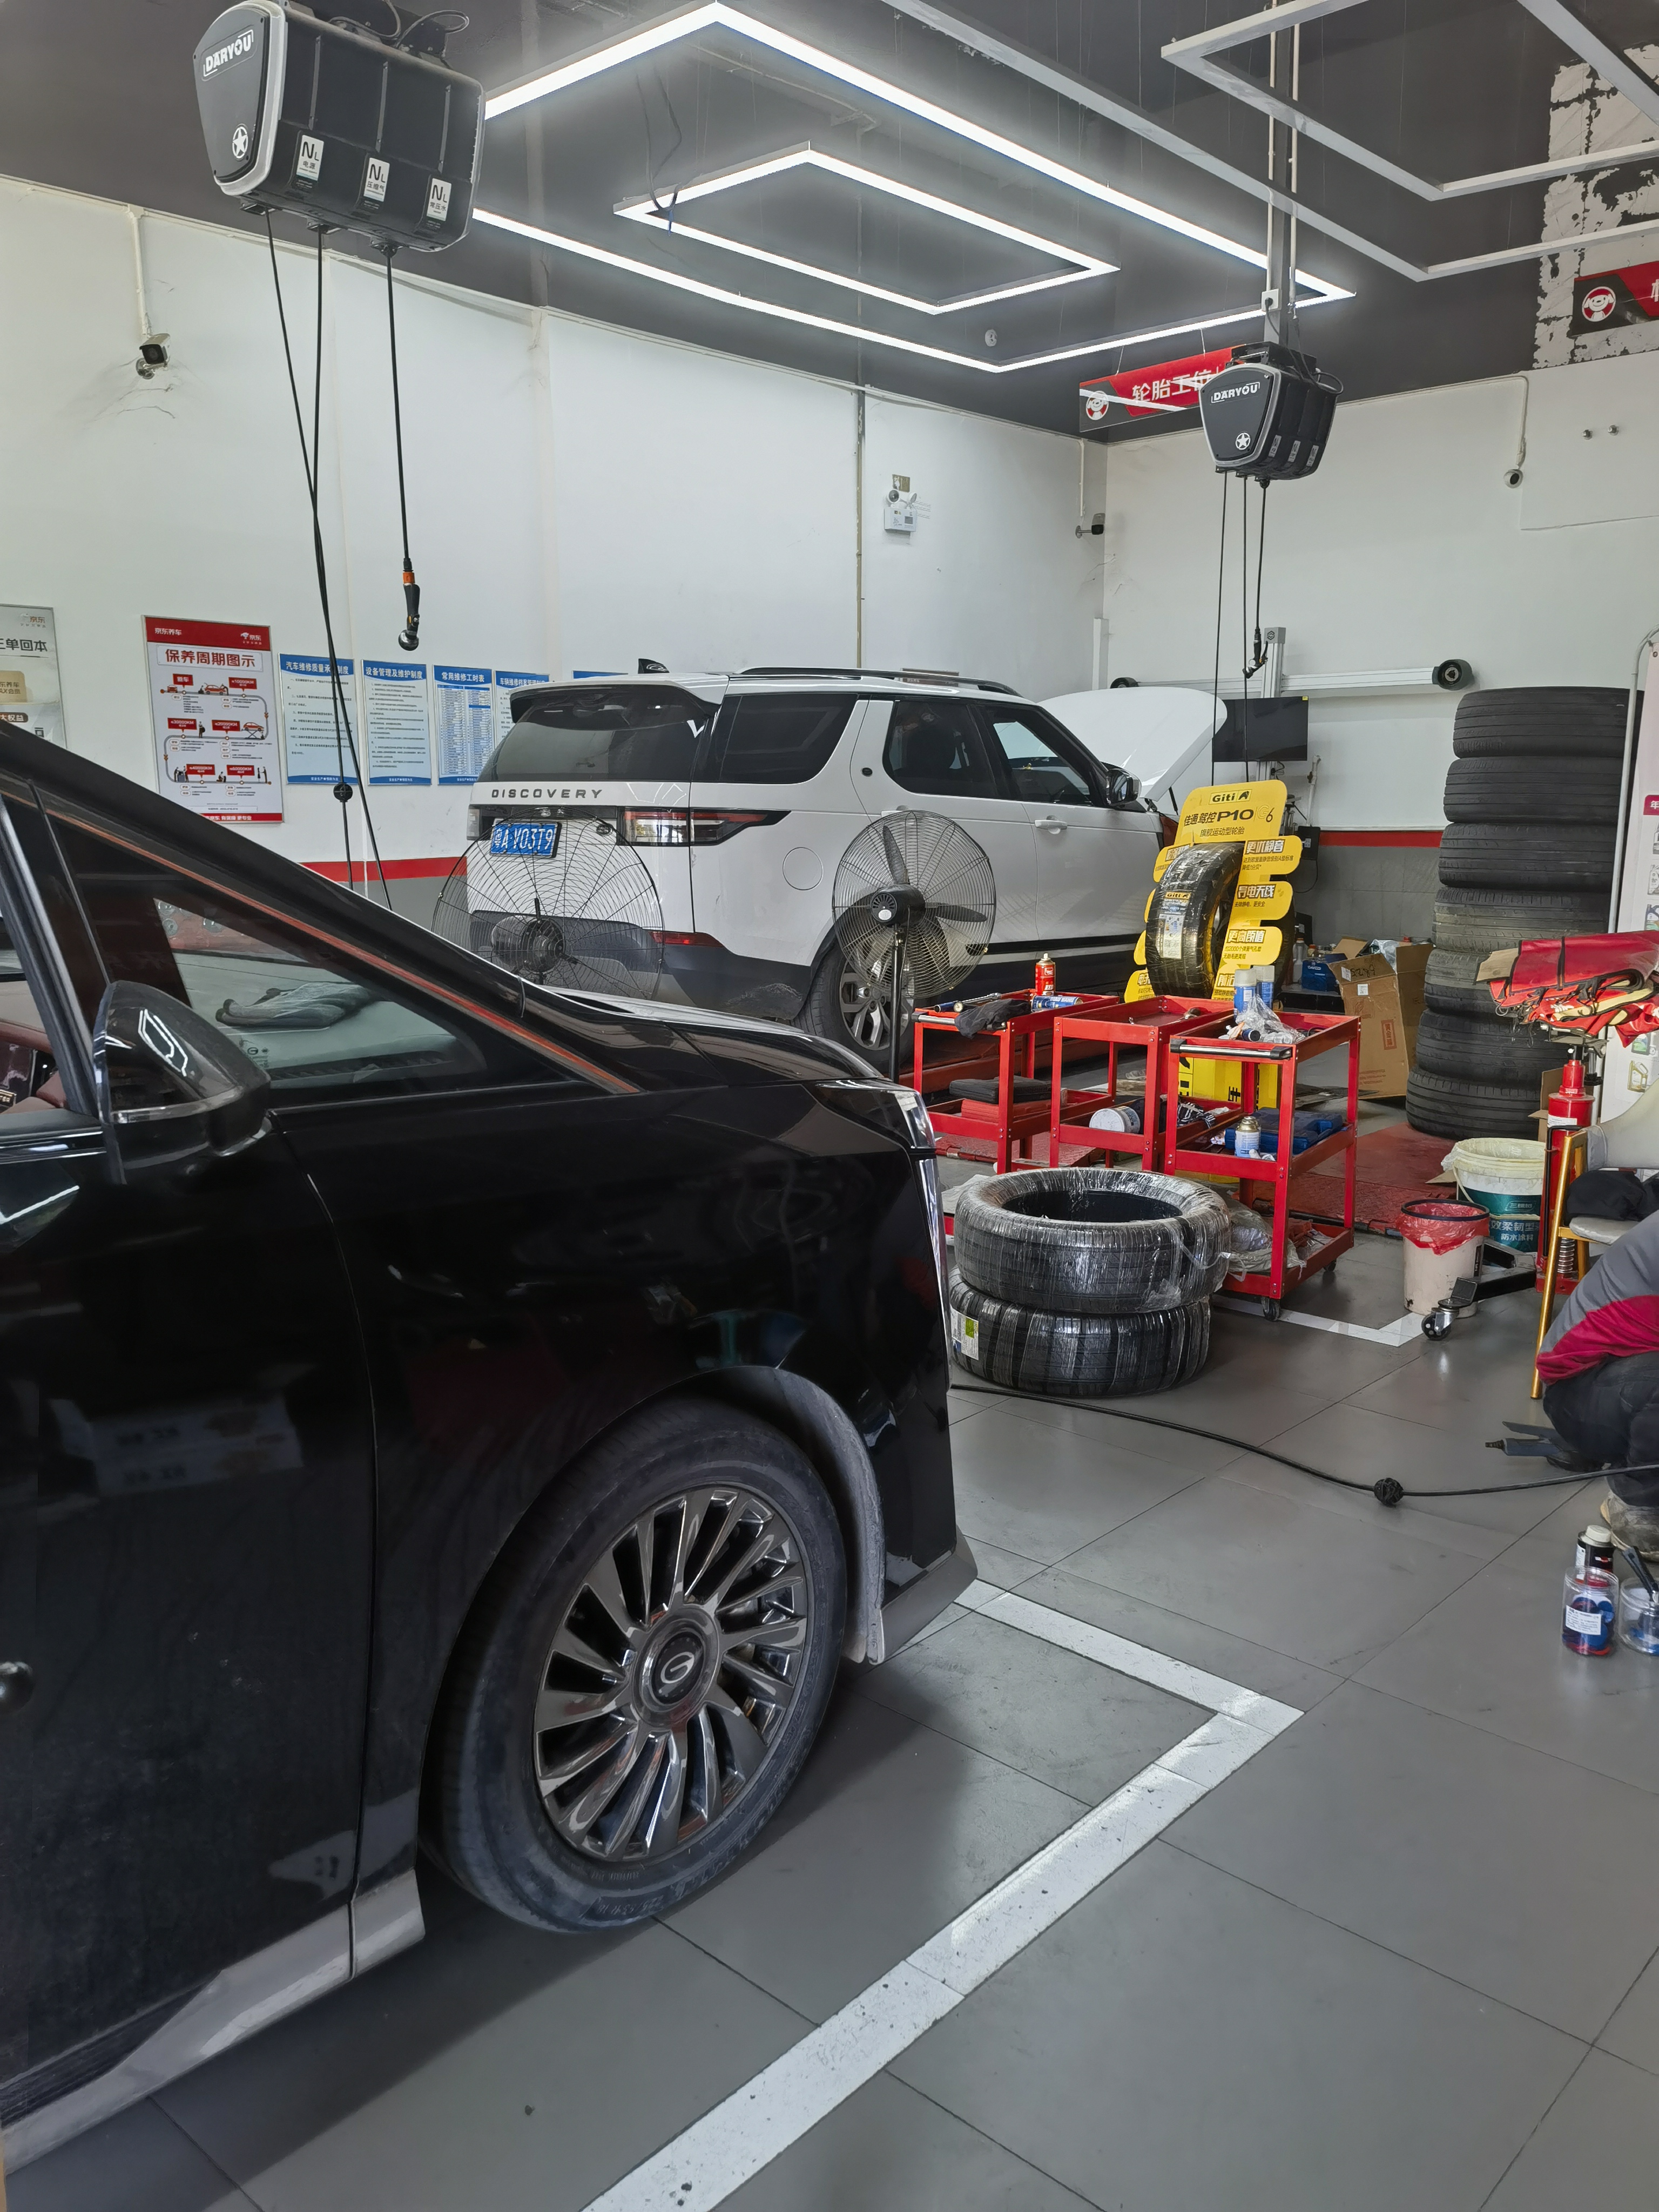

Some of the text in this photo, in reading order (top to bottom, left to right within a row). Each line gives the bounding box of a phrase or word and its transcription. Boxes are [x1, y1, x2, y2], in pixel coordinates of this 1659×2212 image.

[1132, 366, 1219, 403] 轮胎工位
[155, 628, 182, 636] 京东养车
[165, 649, 255, 667] 保养周期图示
[286, 661, 349, 675] 汽车维修质量承制度
[366, 666, 423, 679] 设备管理及维护制度
[441, 672, 485, 683] 常用维修工时表
[491, 788, 602, 798] DISCOVERY
[1212, 793, 1236, 802] Giti
[1237, 885, 1275, 898] 导电天线
[1228, 929, 1265, 943] 更高颜值
[1501, 1233, 1534, 1241] 防水涂料
